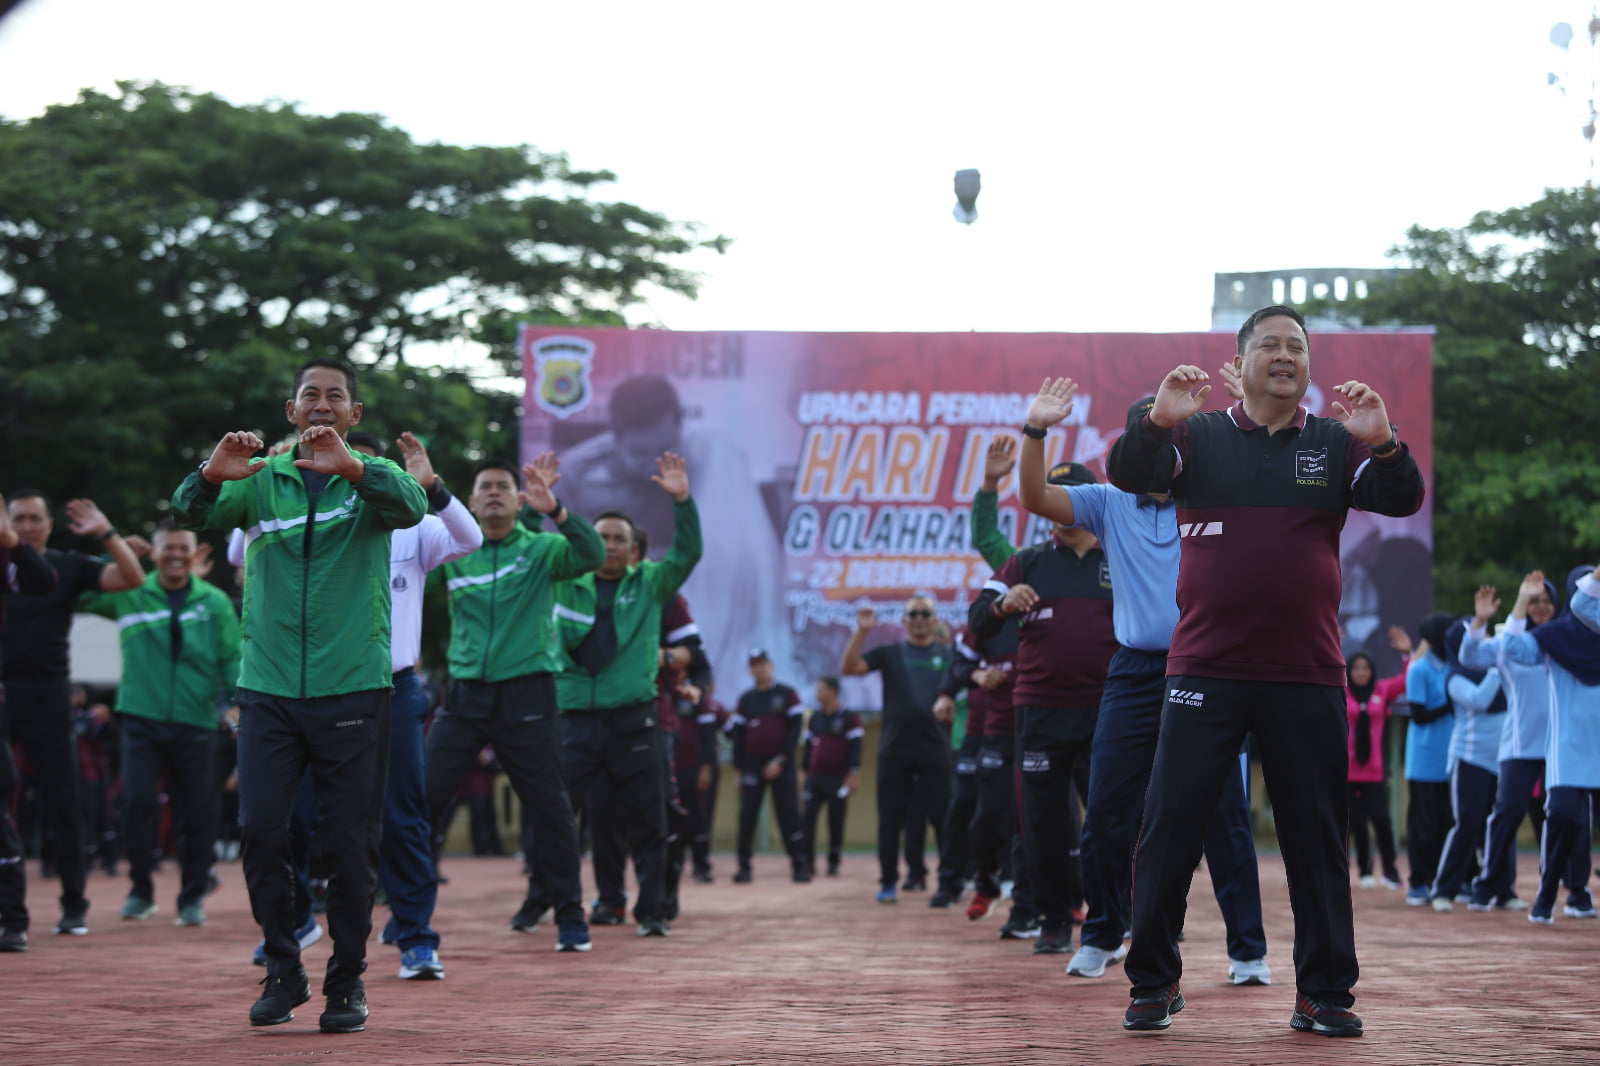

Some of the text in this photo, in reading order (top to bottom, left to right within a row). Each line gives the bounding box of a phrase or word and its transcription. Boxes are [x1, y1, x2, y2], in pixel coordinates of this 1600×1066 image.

[797, 391, 920, 424] UPACARA
[797, 428, 947, 499] HARI
[786, 505, 819, 554] &
[825, 506, 1015, 554] OLAHRAA
